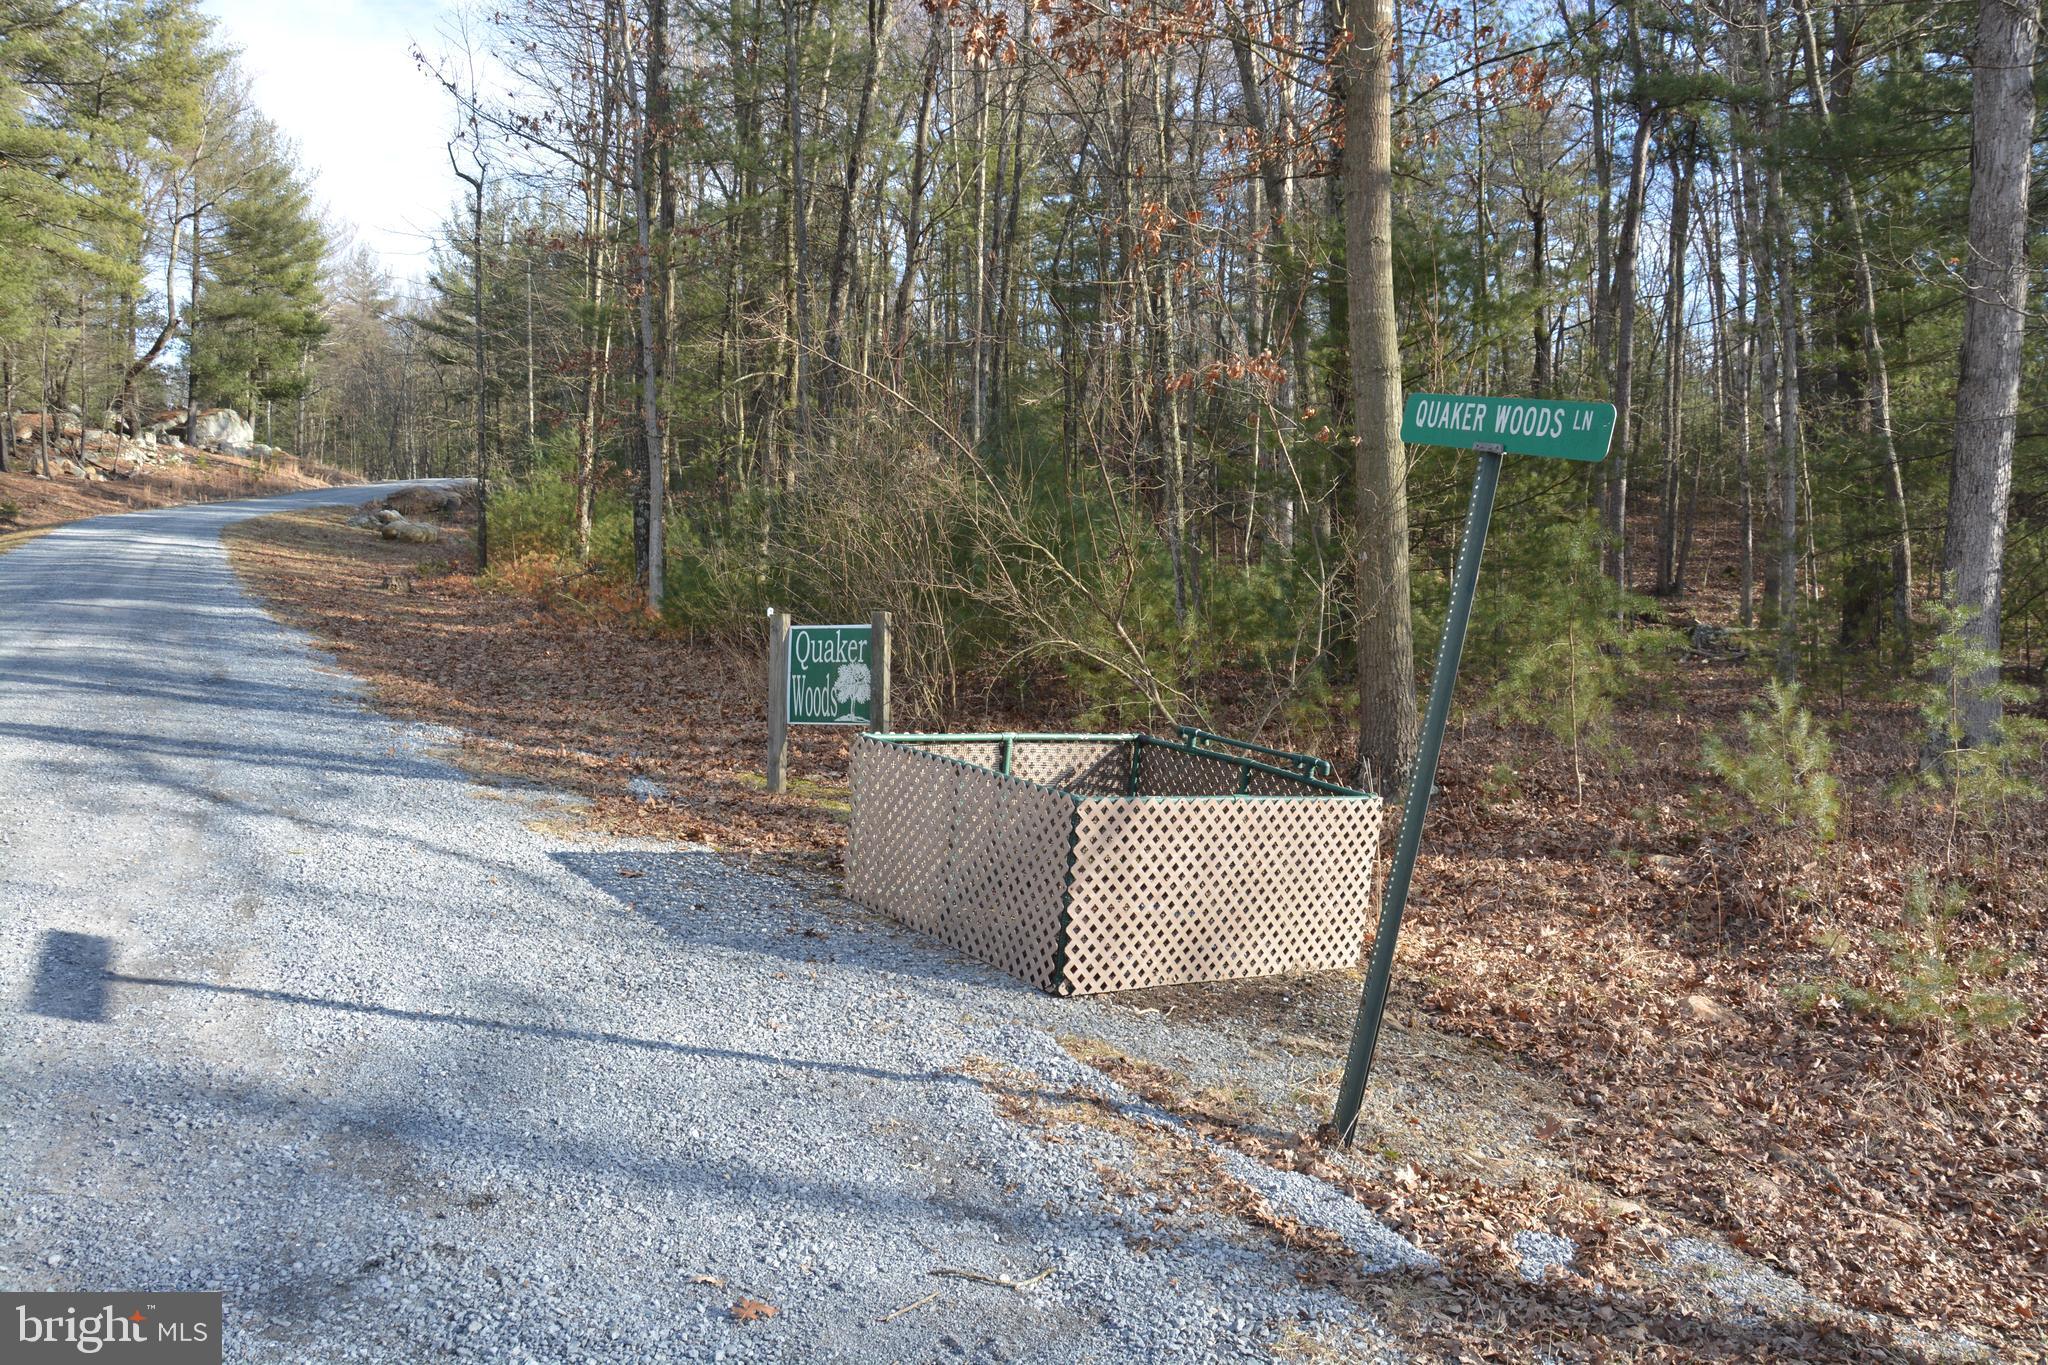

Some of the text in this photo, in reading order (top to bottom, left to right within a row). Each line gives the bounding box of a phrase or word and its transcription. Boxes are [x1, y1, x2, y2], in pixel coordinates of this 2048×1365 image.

[1416, 399, 1594, 438] QUAKER WOODS LN
[796, 629, 868, 670] Quaker
[792, 673, 838, 717] Woods
